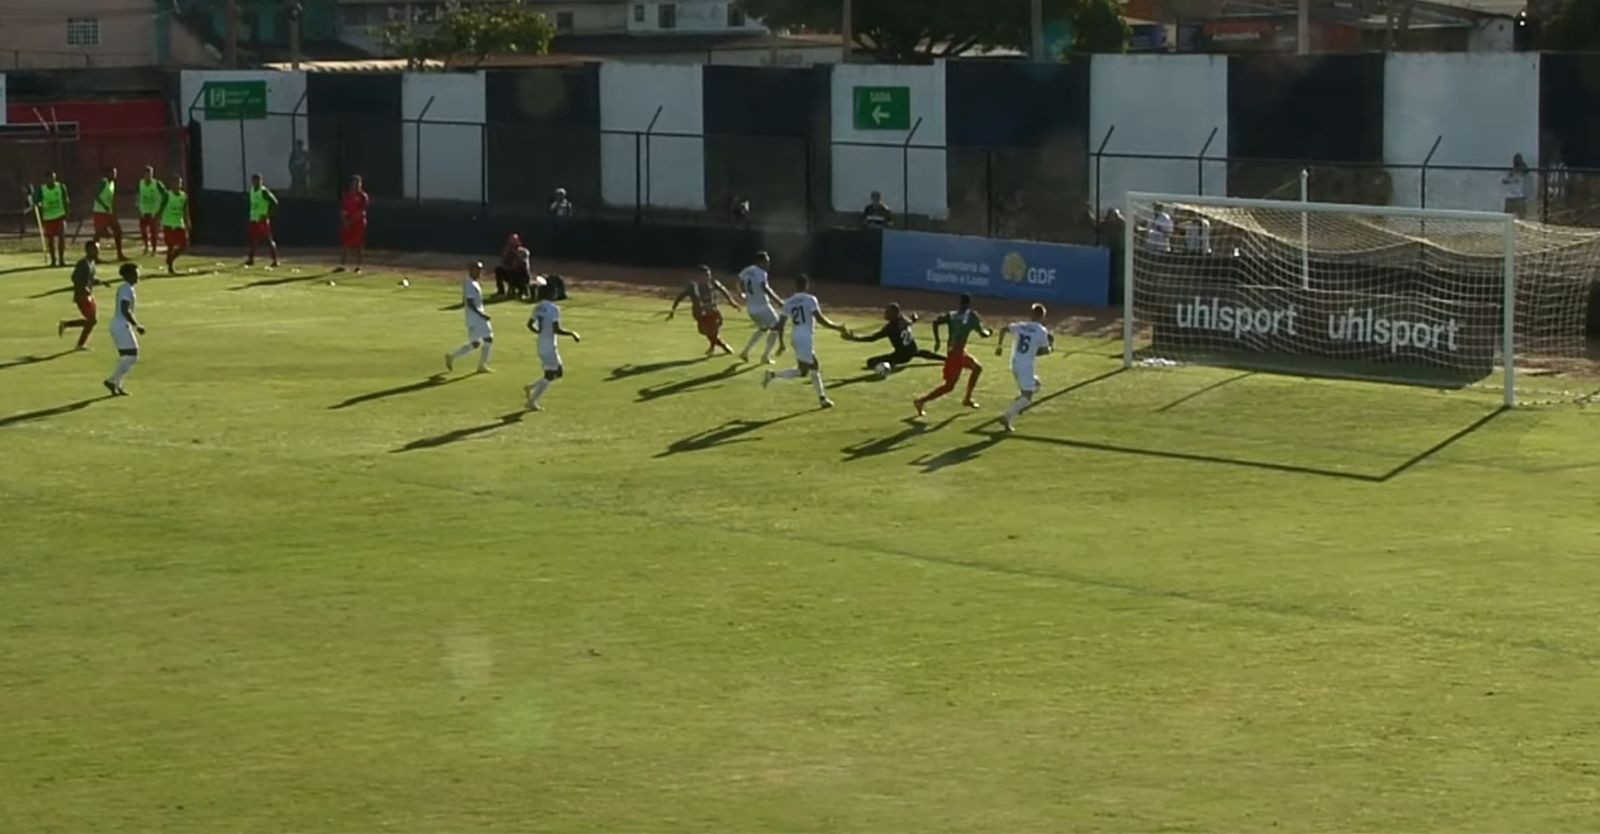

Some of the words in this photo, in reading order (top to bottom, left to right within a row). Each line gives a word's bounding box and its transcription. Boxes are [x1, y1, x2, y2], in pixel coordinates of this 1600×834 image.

[1027, 267, 1057, 285] GDF
[791, 304, 806, 325] 21
[1176, 296, 1298, 339] uhlsport
[1328, 307, 1460, 354] uhlsport
[1017, 332, 1032, 354] 16
